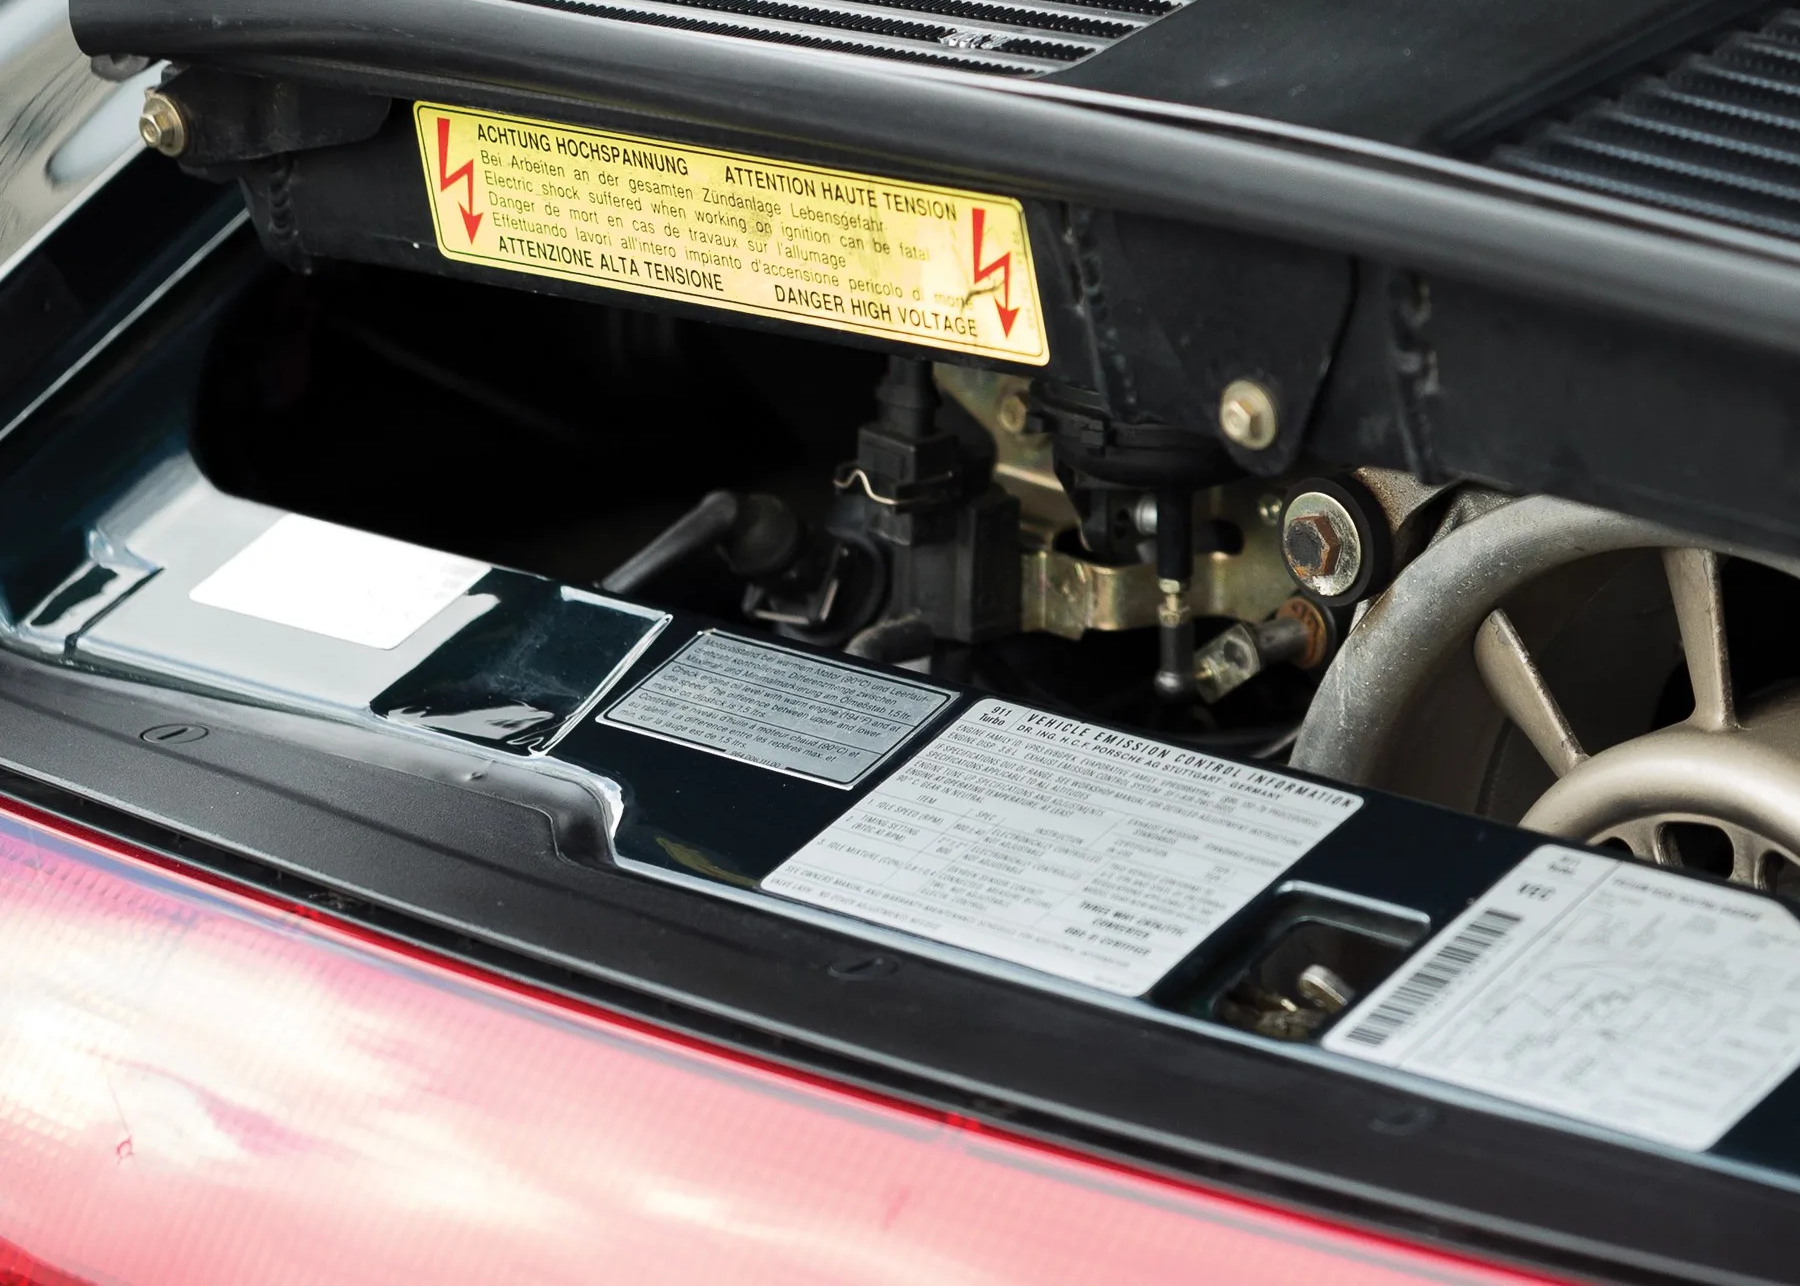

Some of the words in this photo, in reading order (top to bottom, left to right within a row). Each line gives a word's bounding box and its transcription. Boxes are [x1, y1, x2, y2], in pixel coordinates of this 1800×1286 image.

[477, 123, 551, 152] ACHTUNG
[555, 136, 688, 176] HOCHSPANNUNG
[480, 149, 502, 166] Bei
[511, 154, 565, 177] Arbeiten
[573, 168, 590, 181] an
[598, 170, 619, 186] der
[628, 178, 693, 199] gesamten
[701, 187, 781, 217] Zündanlage
[790, 203, 883, 232] Lebensgefahr
[484, 169, 533, 192] Electric
[541, 181, 580, 200] shock
[588, 190, 642, 211] suffered
[650, 200, 686, 218] when
[694, 210, 747, 233] working
[755, 220, 772, 233] on
[780, 221, 830, 243] ignition
[839, 235, 864, 249] can
[871, 237, 890, 254] be
[725, 165, 816, 197] ATTENTION
[820, 181, 877, 208] HAUTE
[882, 191, 956, 220] TENSION
[488, 190, 534, 214] Danger
[544, 202, 560, 217] de
[569, 208, 599, 224] mort
[607, 215, 623, 227] en
[631, 219, 655, 234] cas
[663, 222, 680, 238] de
[688, 227, 738, 247] travaux
[747, 240, 767, 253] sur
[777, 241, 846, 270] l'allumage
[492, 211, 567, 239] Effettuando
[575, 226, 612, 246] lavori
[620, 236, 676, 258] all'intero
[685, 249, 742, 269] impianto
[750, 258, 839, 287] d'accensione
[848, 278, 903, 298] pericolo
[499, 235, 594, 268] ATTENZIONE
[600, 253, 640, 276] ALTA
[643, 261, 724, 291] TENSIONE
[774, 284, 844, 313] DANGER
[850, 298, 891, 321] HIGH
[897, 306, 977, 337] VOLTAGE
[724, 666, 744, 675] und
[813, 668, 841, 680] Motor
[871, 684, 891, 692] und
[651, 682, 679, 693] marks
[692, 693, 726, 706] dipstick
[671, 665, 699, 678] Check
[699, 674, 730, 686] engine
[741, 685, 765, 695] level
[763, 692, 782, 701] with
[783, 697, 808, 707] warm
[808, 704, 839, 716] engine
[871, 721, 892, 729] and
[709, 686, 726, 696] The
[726, 692, 770, 708] difference
[771, 704, 809, 719] between
[809, 715, 837, 725] upper
[836, 722, 857, 731] and
[855, 691, 897, 705] zwischen
[991, 706, 1012, 716] 911
[660, 721, 688, 732] jauge
[688, 728, 704, 736] est
[688, 707, 719, 719] niveau
[757, 726, 789, 738] moteur
[789, 735, 819, 746] chaud
[955, 724, 986, 737] ENGINE
[984, 731, 1013, 744] FAMILY
[979, 713, 1005, 726] Turbo
[728, 729, 753, 739] entre
[753, 734, 767, 743] les
[802, 749, 823, 759] max.
[942, 745, 1001, 765] SPECIFICATIONS
[999, 760, 1017, 770] OUT
[947, 731, 977, 744] ENGINE
[1023, 752, 1058, 766] EXHAUST
[1056, 761, 1095, 777] EMISSION
[1095, 772, 1130, 787] CONTROL
[1016, 724, 1033, 734] DR.
[1032, 728, 1063, 742] ING.
[1091, 745, 1142, 763] PORSCHE
[1161, 764, 1221, 783] STUTTGART
[1229, 782, 1280, 800] GERMANY
[1027, 713, 1090, 736] VEHICLE
[1093, 731, 1170, 758] EMISSION
[1174, 753, 1240, 777] CONTROL
[1247, 773, 1351, 807] INFORMATION
[905, 767, 935, 780] ENGINE
[943, 778, 985, 793] OPERATING
[913, 759, 944, 772] ENGINE
[975, 777, 1034, 797] SPECIFICATIONS
[1032, 793, 1051, 802] AND
[925, 750, 983, 770] SPECIFICATIONS
[981, 765, 1026, 782] APPLICABLE
[1035, 781, 1049, 789] ALL
[1050, 784, 1091, 800] ALTITUDES
